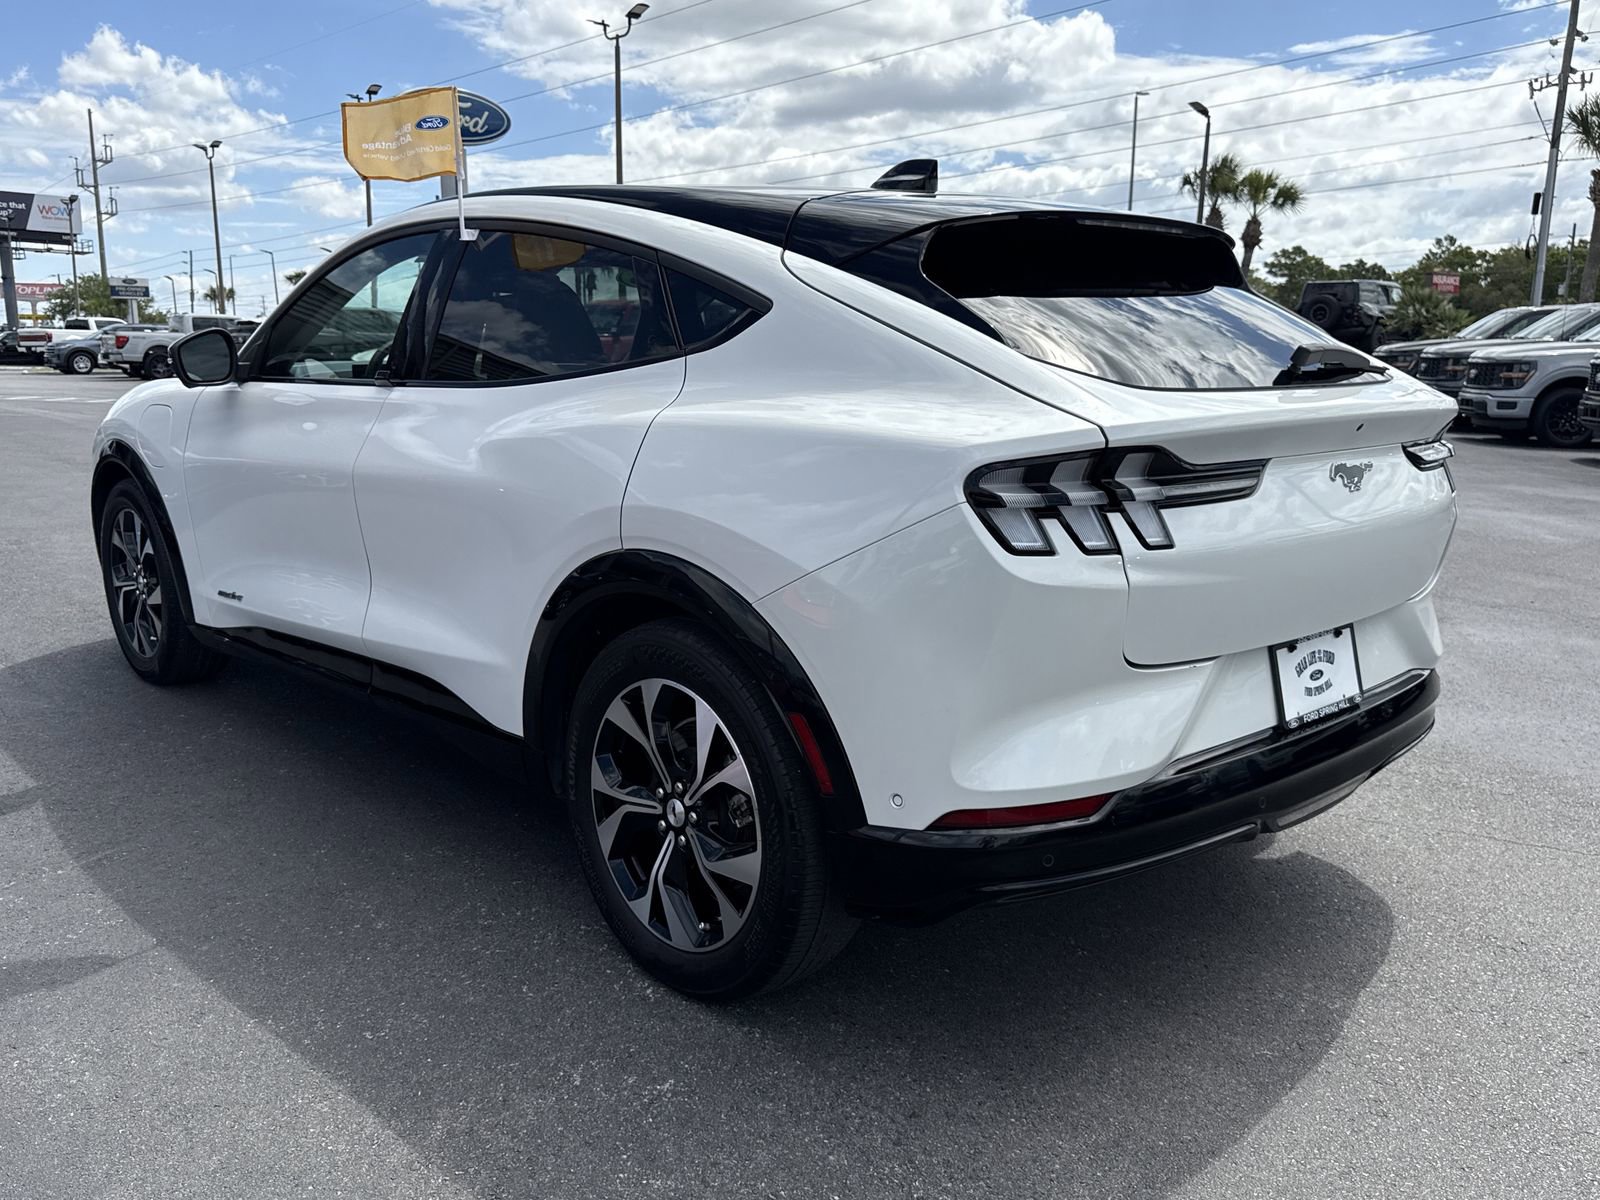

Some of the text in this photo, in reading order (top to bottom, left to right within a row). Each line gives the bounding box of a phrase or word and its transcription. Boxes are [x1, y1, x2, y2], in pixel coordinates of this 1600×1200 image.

[9, 201, 26, 209] that
[1303, 700, 1350, 723] FORD SPRING HILL
